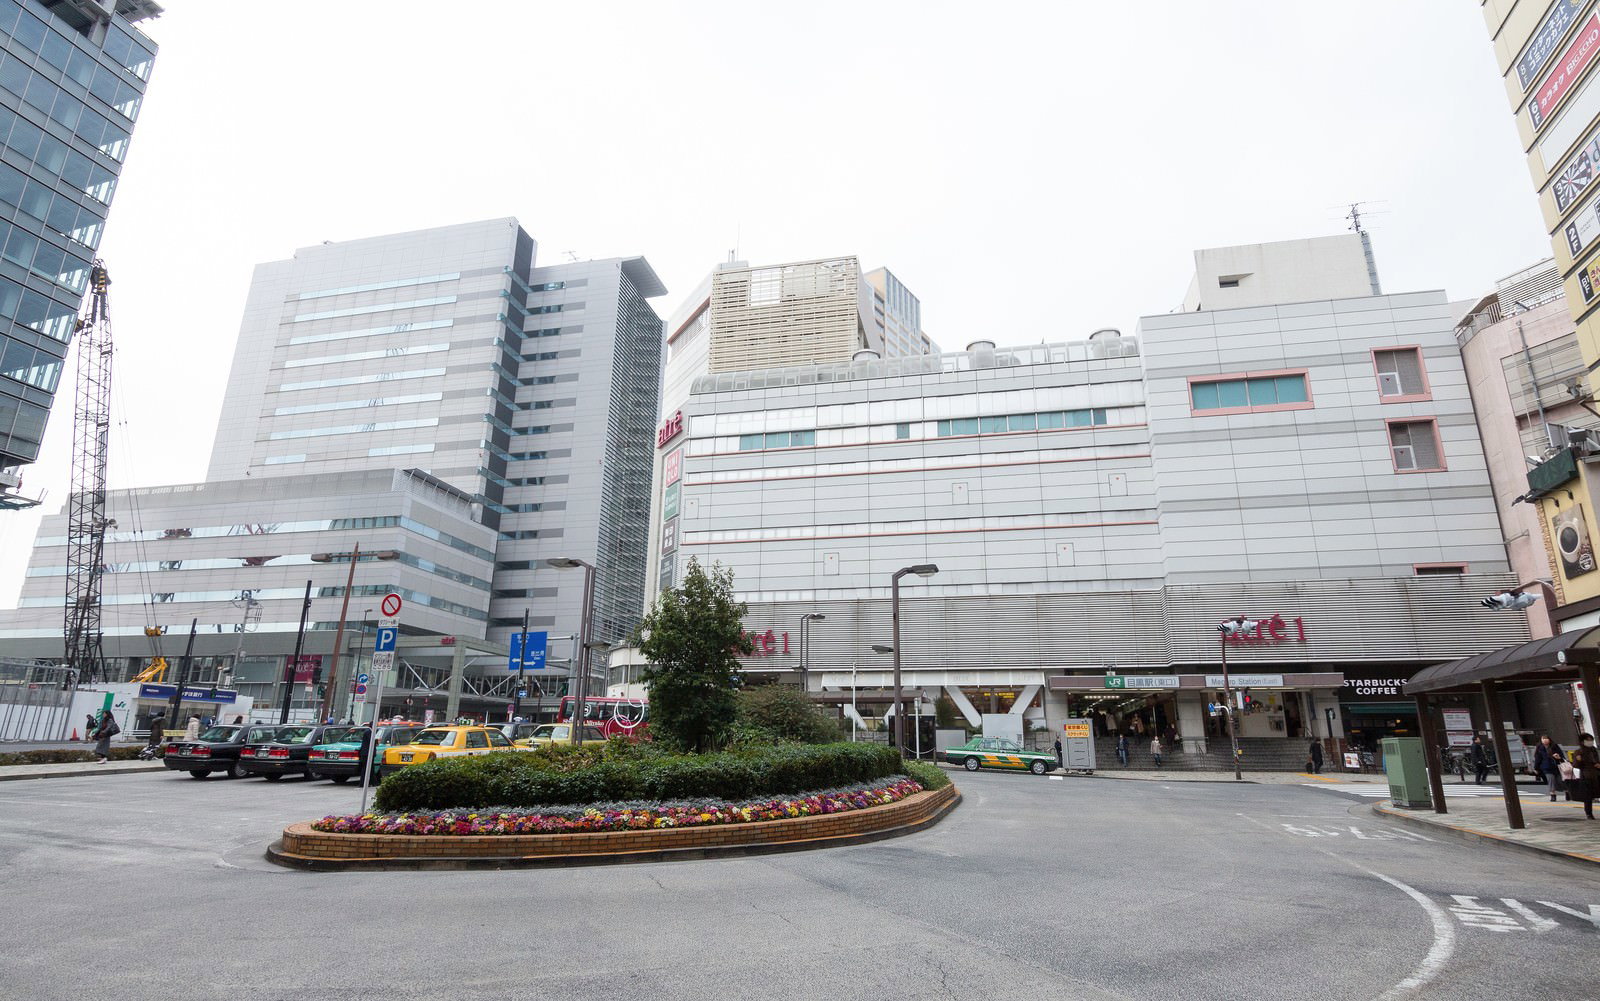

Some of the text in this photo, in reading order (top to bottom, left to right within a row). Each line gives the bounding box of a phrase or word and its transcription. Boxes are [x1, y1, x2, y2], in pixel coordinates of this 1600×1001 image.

[1527, 5, 1566, 62] インターネット
[1529, 12, 1569, 72] コミックカフェ
[1541, 73, 1565, 109] カラオケ
[1579, 29, 1599, 58] ECHO
[1531, 102, 1541, 125] 6F
[1556, 182, 1566, 207] 3F
[1569, 227, 1579, 252] 2F
[379, 630, 393, 650] P
[782, 631, 790, 653] 1
[1211, 678, 1236, 686] Megro
[1238, 677, 1262, 686] Station
[1343, 679, 1408, 687] STARBUCKS
[1356, 687, 1397, 695] COFFEE
